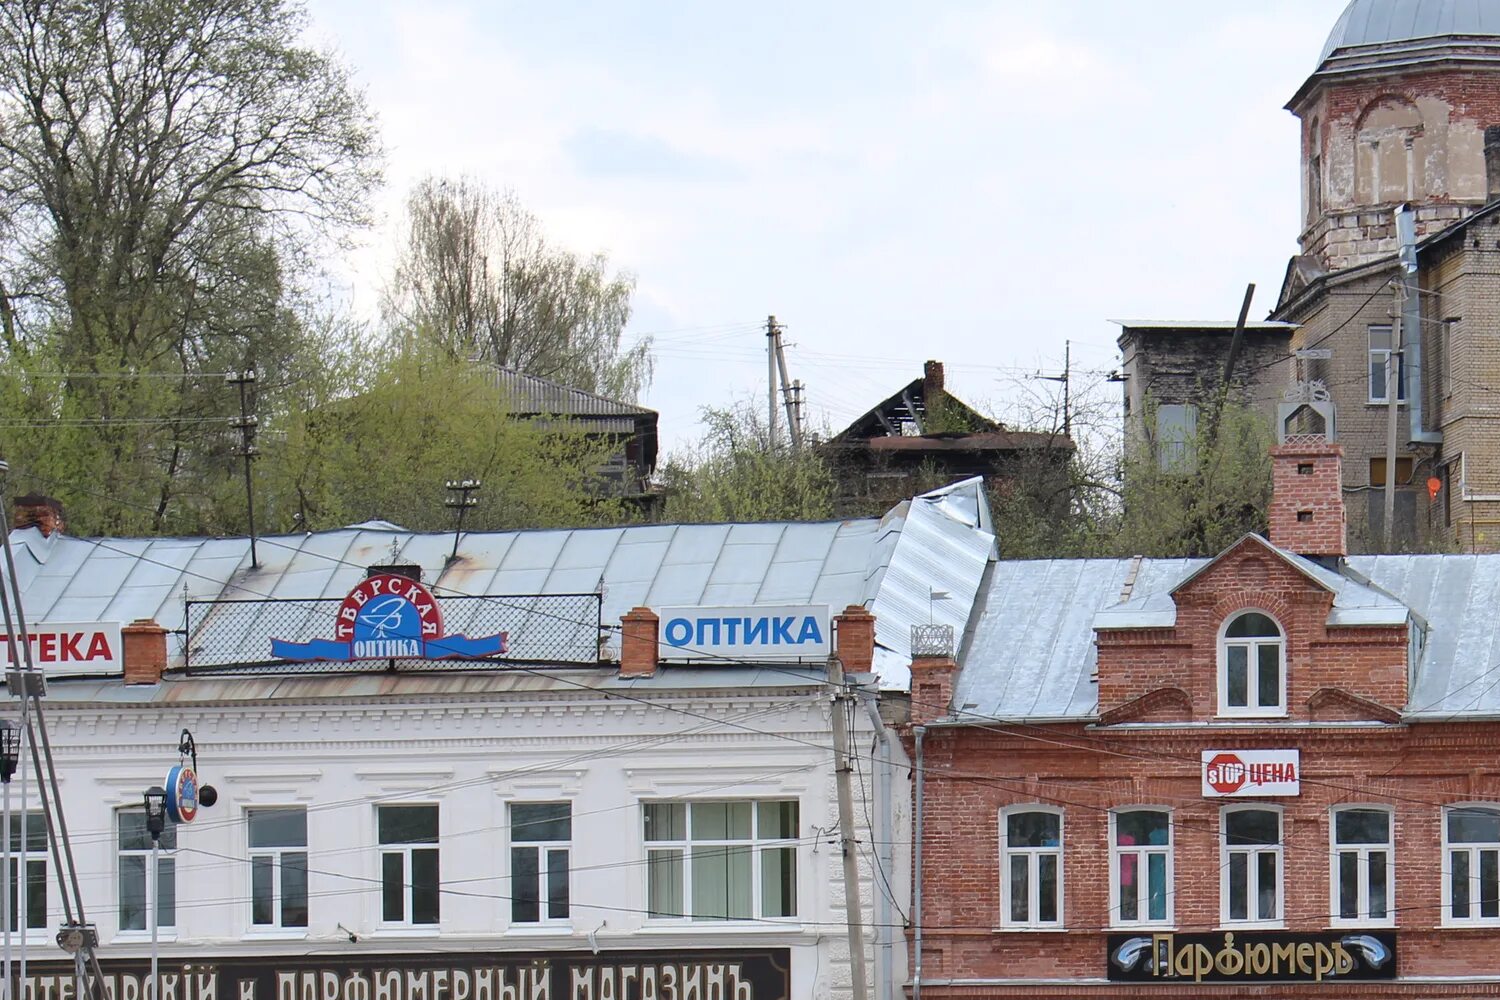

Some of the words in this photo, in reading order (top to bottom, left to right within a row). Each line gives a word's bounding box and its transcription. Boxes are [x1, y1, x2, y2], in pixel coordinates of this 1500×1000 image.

[338, 578, 437, 637] ТВЕРСКАЯ
[665, 616, 823, 646] ОПТИКА
[354, 640, 419, 658] ОПТИКА
[1250, 763, 1295, 786] ЦЕНА
[1153, 932, 1353, 982] Парфюмеръ
